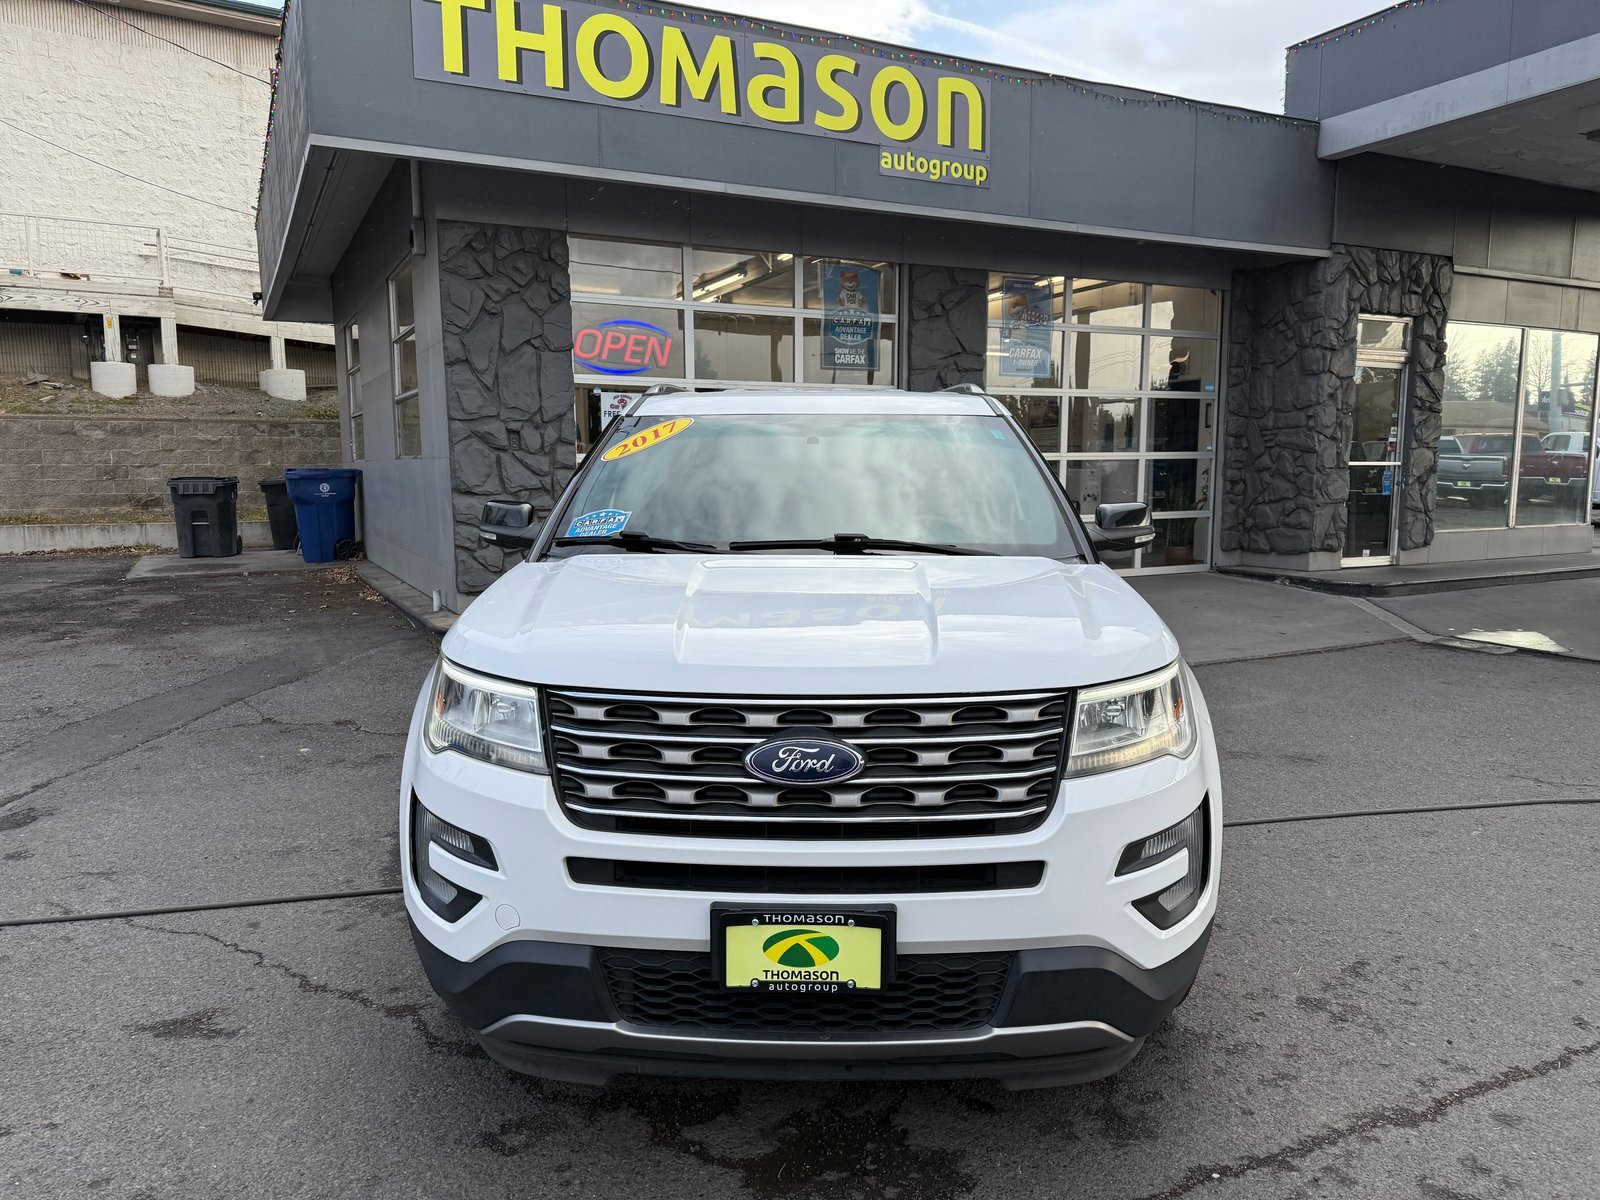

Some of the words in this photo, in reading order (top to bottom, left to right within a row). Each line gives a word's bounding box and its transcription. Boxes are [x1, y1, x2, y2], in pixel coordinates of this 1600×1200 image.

[880, 148, 989, 186] autogroup
[834, 317, 871, 326] CARFAX
[834, 326, 868, 334] ADVANTAGE
[574, 328, 673, 369] OPEN
[1009, 347, 1042, 359] CARFAX
[834, 354, 866, 364] CARFAX
[615, 421, 677, 457] 2017
[576, 515, 626, 527] CARFAX
[575, 523, 617, 534] ADVANTAGE
[771, 746, 836, 773] Ford
[768, 982, 839, 993] autogroup
